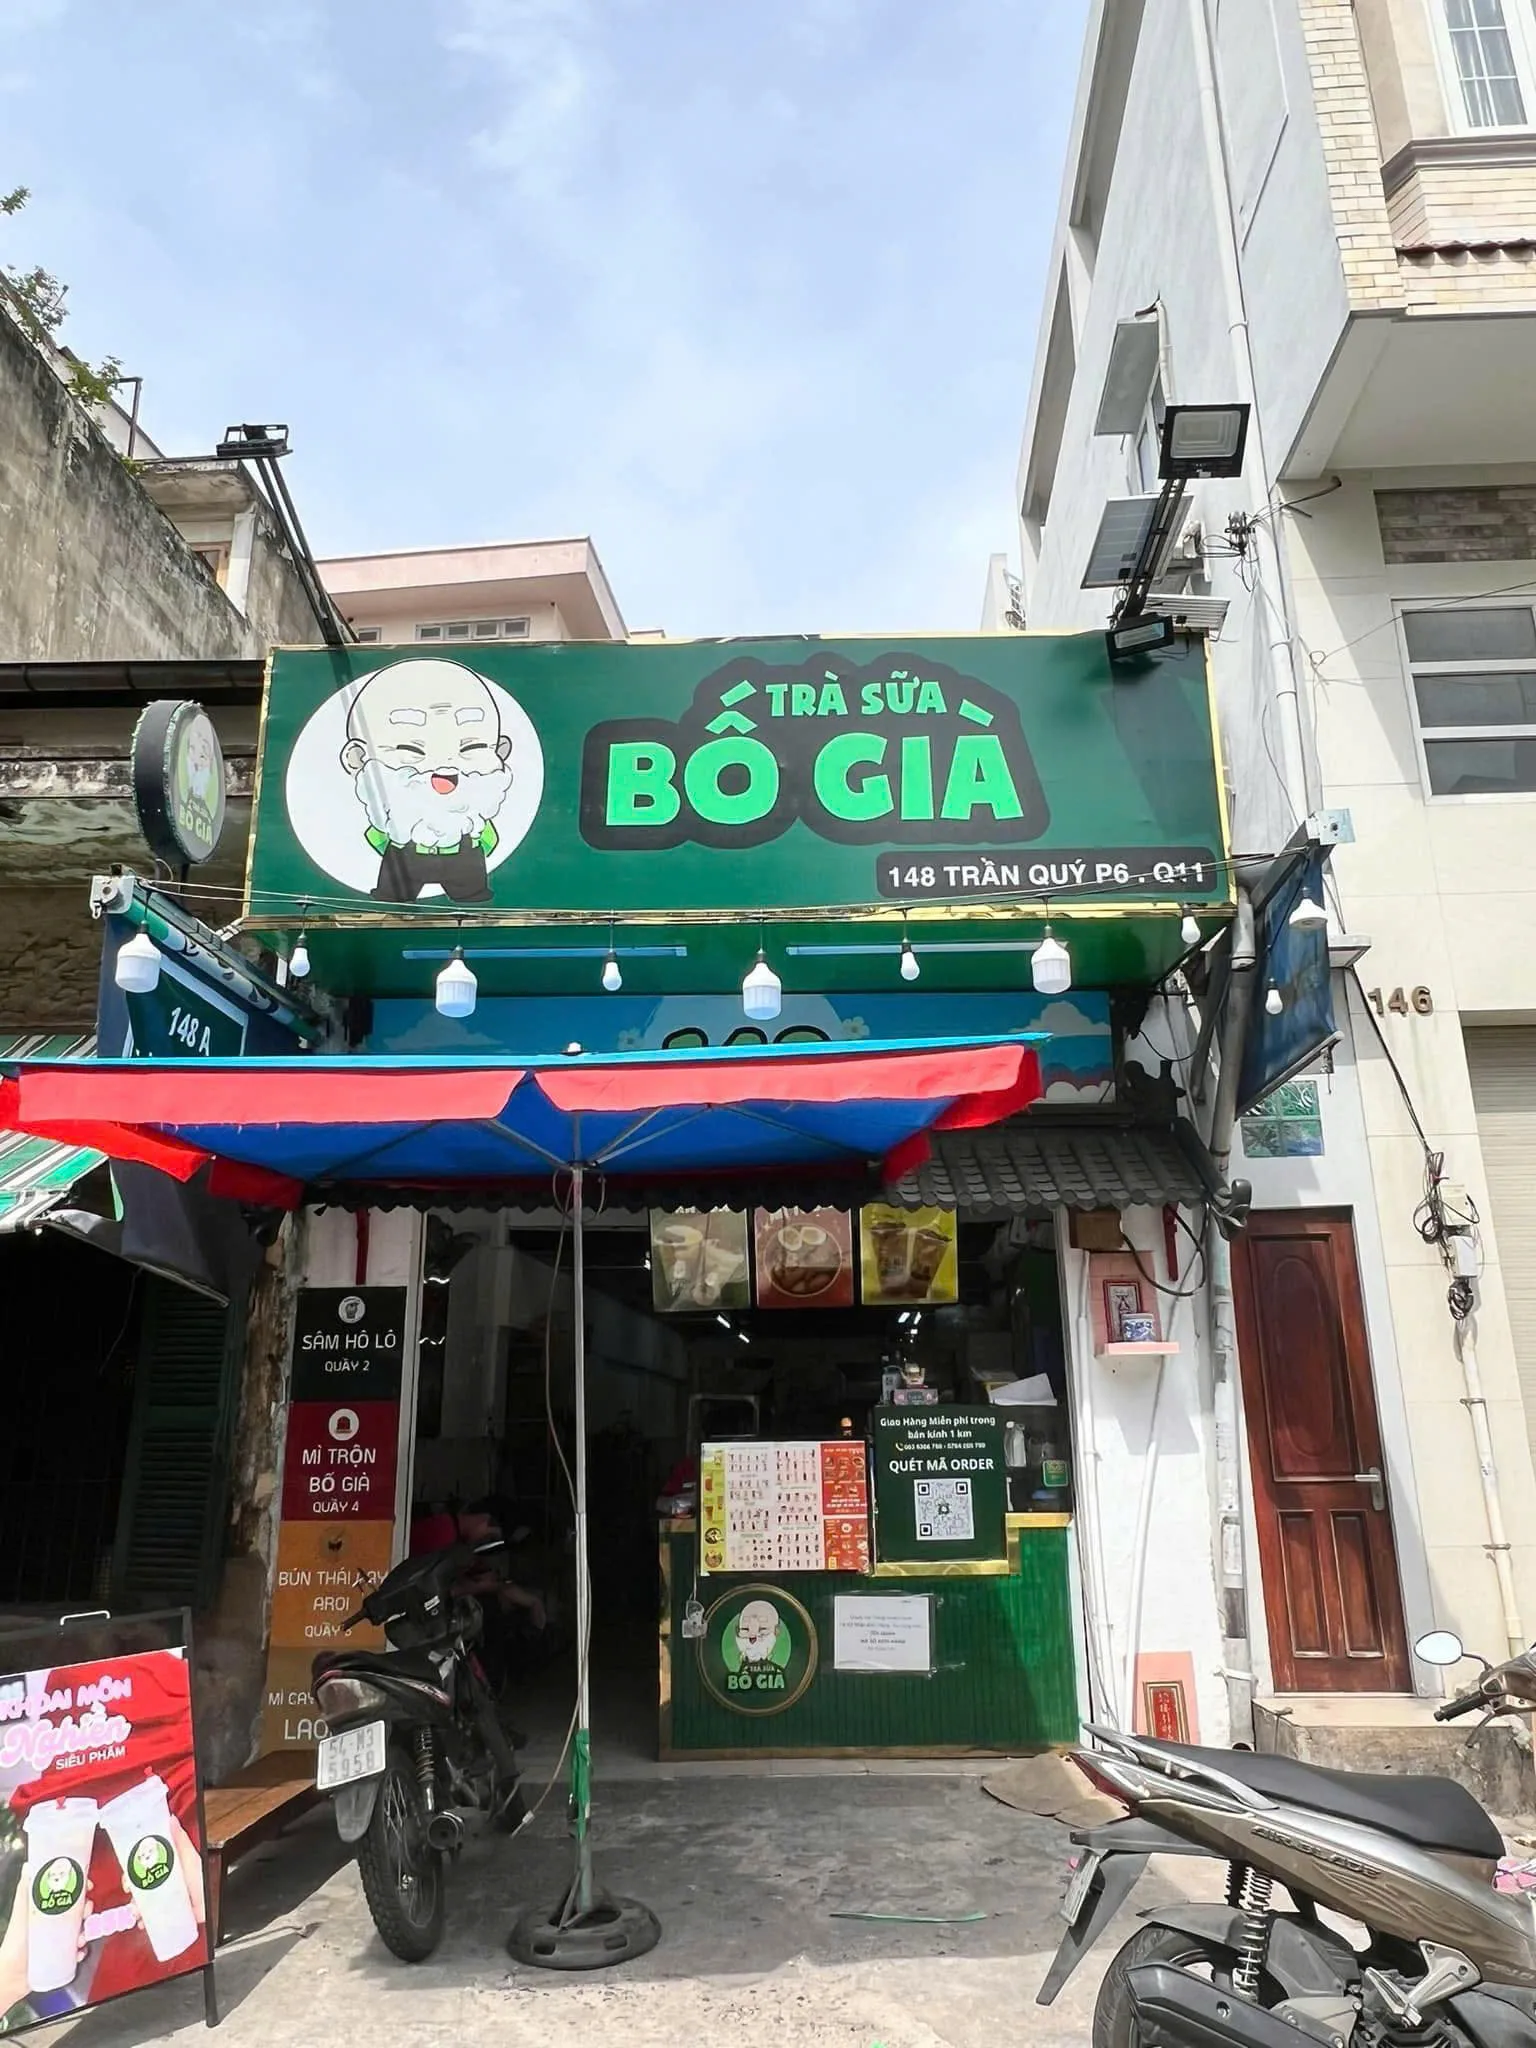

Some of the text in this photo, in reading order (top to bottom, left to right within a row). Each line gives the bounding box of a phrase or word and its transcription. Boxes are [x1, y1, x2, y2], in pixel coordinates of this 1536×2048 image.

[765, 670, 948, 718] TRÀ SỮA
[606, 680, 1025, 826] BỐ GIÀ
[888, 866, 936, 888] 148
[942, 857, 1021, 887] TRẦN
[1028, 858, 1088, 887] QUÝ
[1096, 863, 1129, 883] P6
[1152, 861, 1205, 884] Q11
[1367, 985, 1434, 1017] 146
[302, 1331, 340, 1351] SÂM
[375, 1329, 397, 1349] LÔ
[363, 1360, 371, 1372] 2
[970, 1416, 996, 1427] trong
[957, 1429, 972, 1438] km
[302, 1444, 377, 1468] MÌ TRỘN
[889, 1457, 994, 1474] QUÉT MÃ ORDER
[309, 1472, 370, 1493] BỐ GIÀ
[351, 1500, 359, 1512] 4
[278, 1567, 312, 1587] BÚN
[316, 1567, 352, 1586] THÁI
[312, 1596, 350, 1612] AROI
[727, 1666, 785, 1690] BỐ GIÀ
[77, 1675, 132, 1708] MÔN
[55, 1748, 87, 1771] SIÊU
